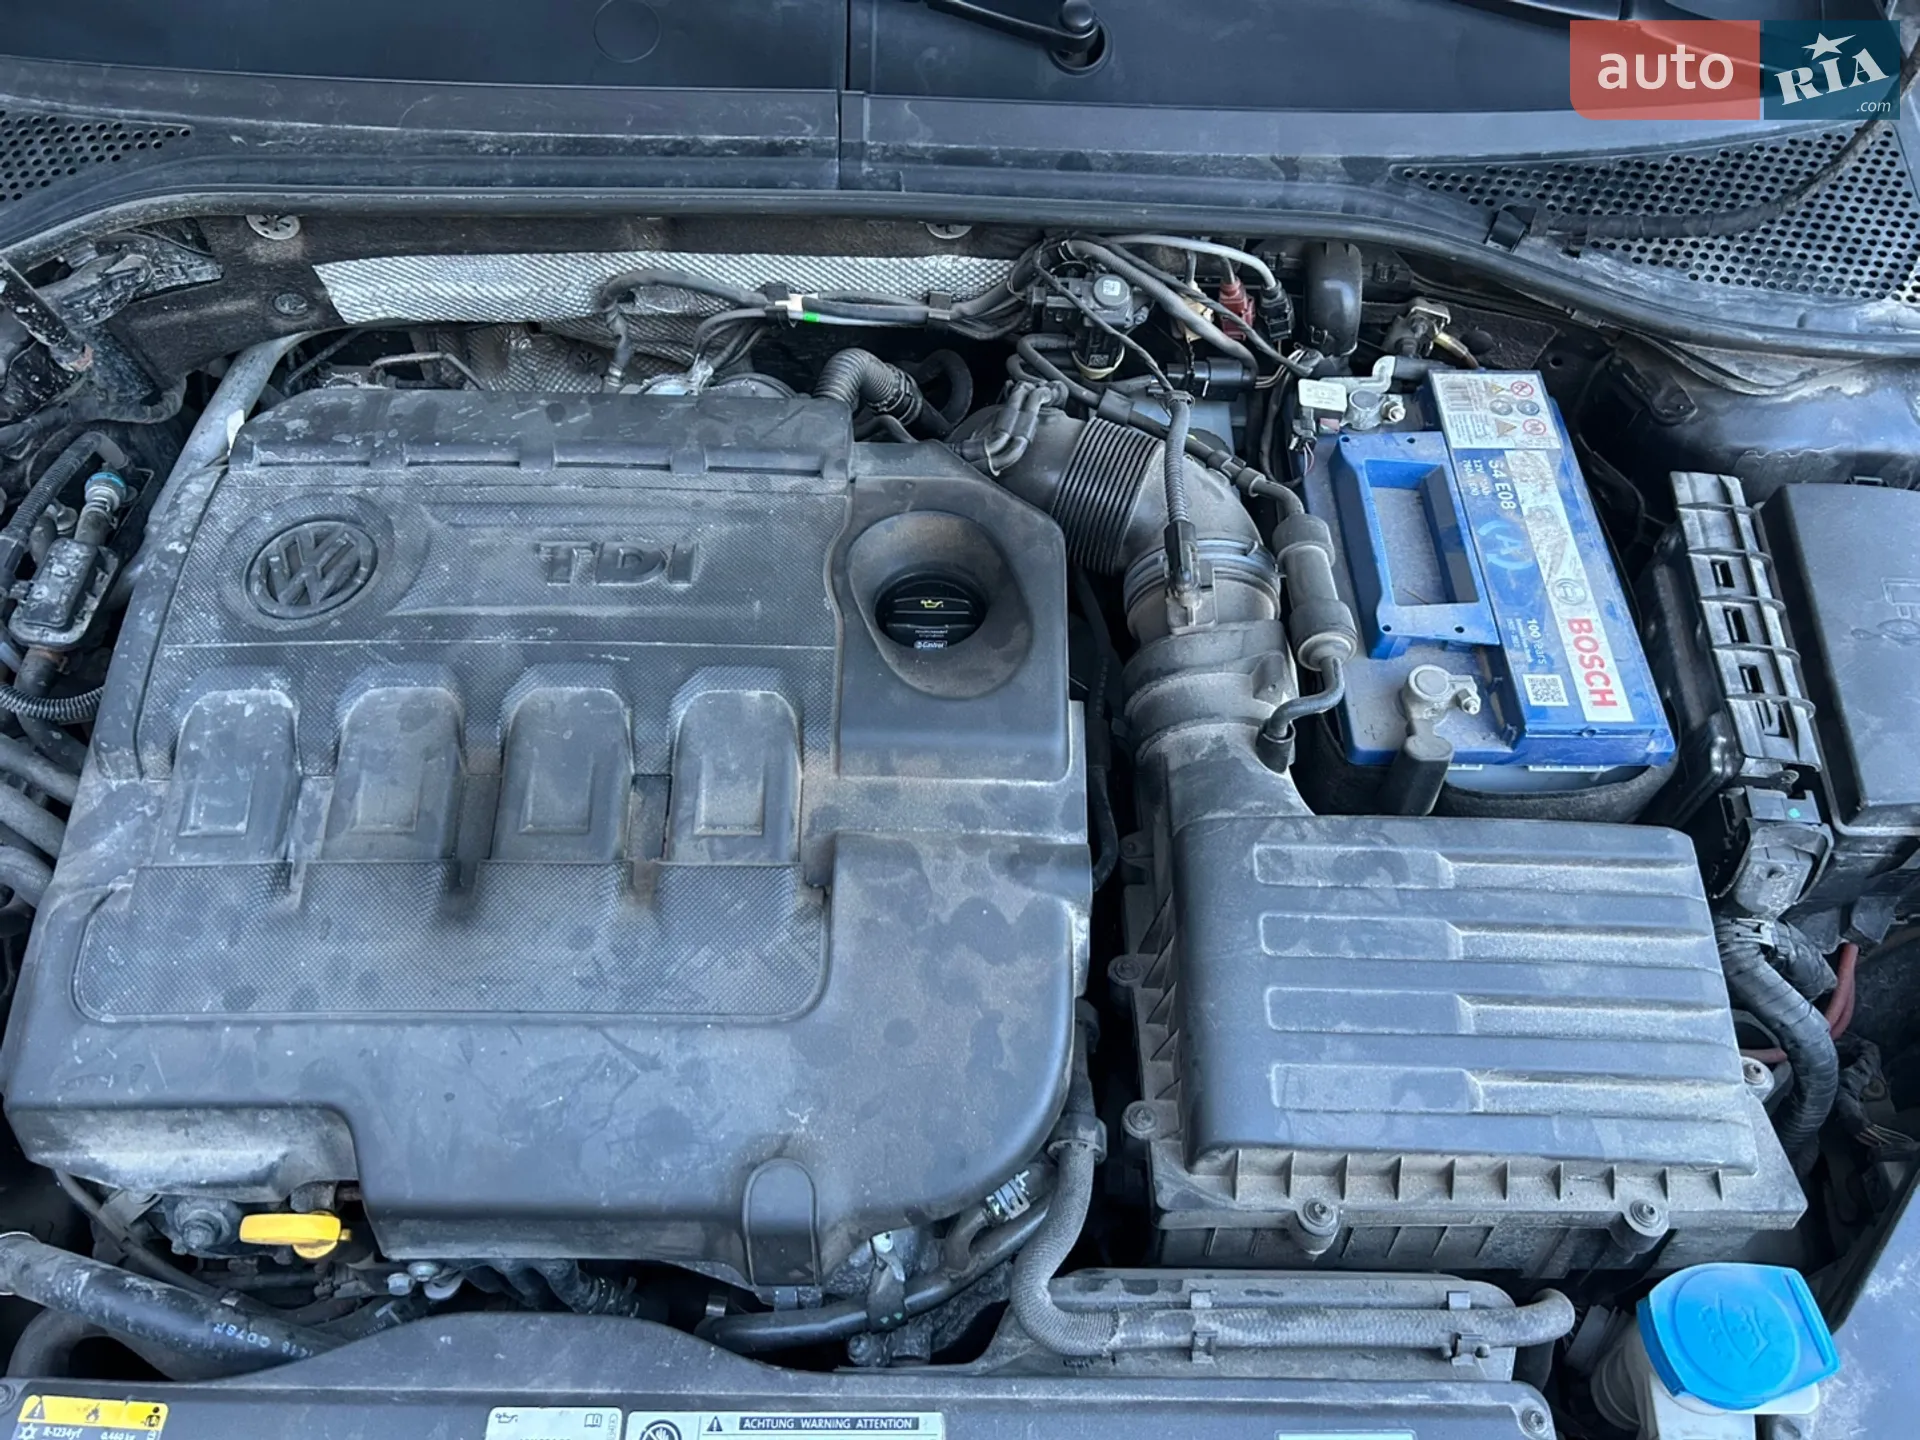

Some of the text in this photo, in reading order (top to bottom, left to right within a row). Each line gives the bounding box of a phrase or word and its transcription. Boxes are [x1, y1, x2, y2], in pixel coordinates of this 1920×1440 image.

[1494, 482, 1517, 510] E08
[534, 540, 698, 587] TDI
[1526, 618, 1543, 639] 100
[1566, 617, 1618, 707] BOSCH
[742, 1417, 913, 1430] ACHTUNG WARNING ATTENTION
